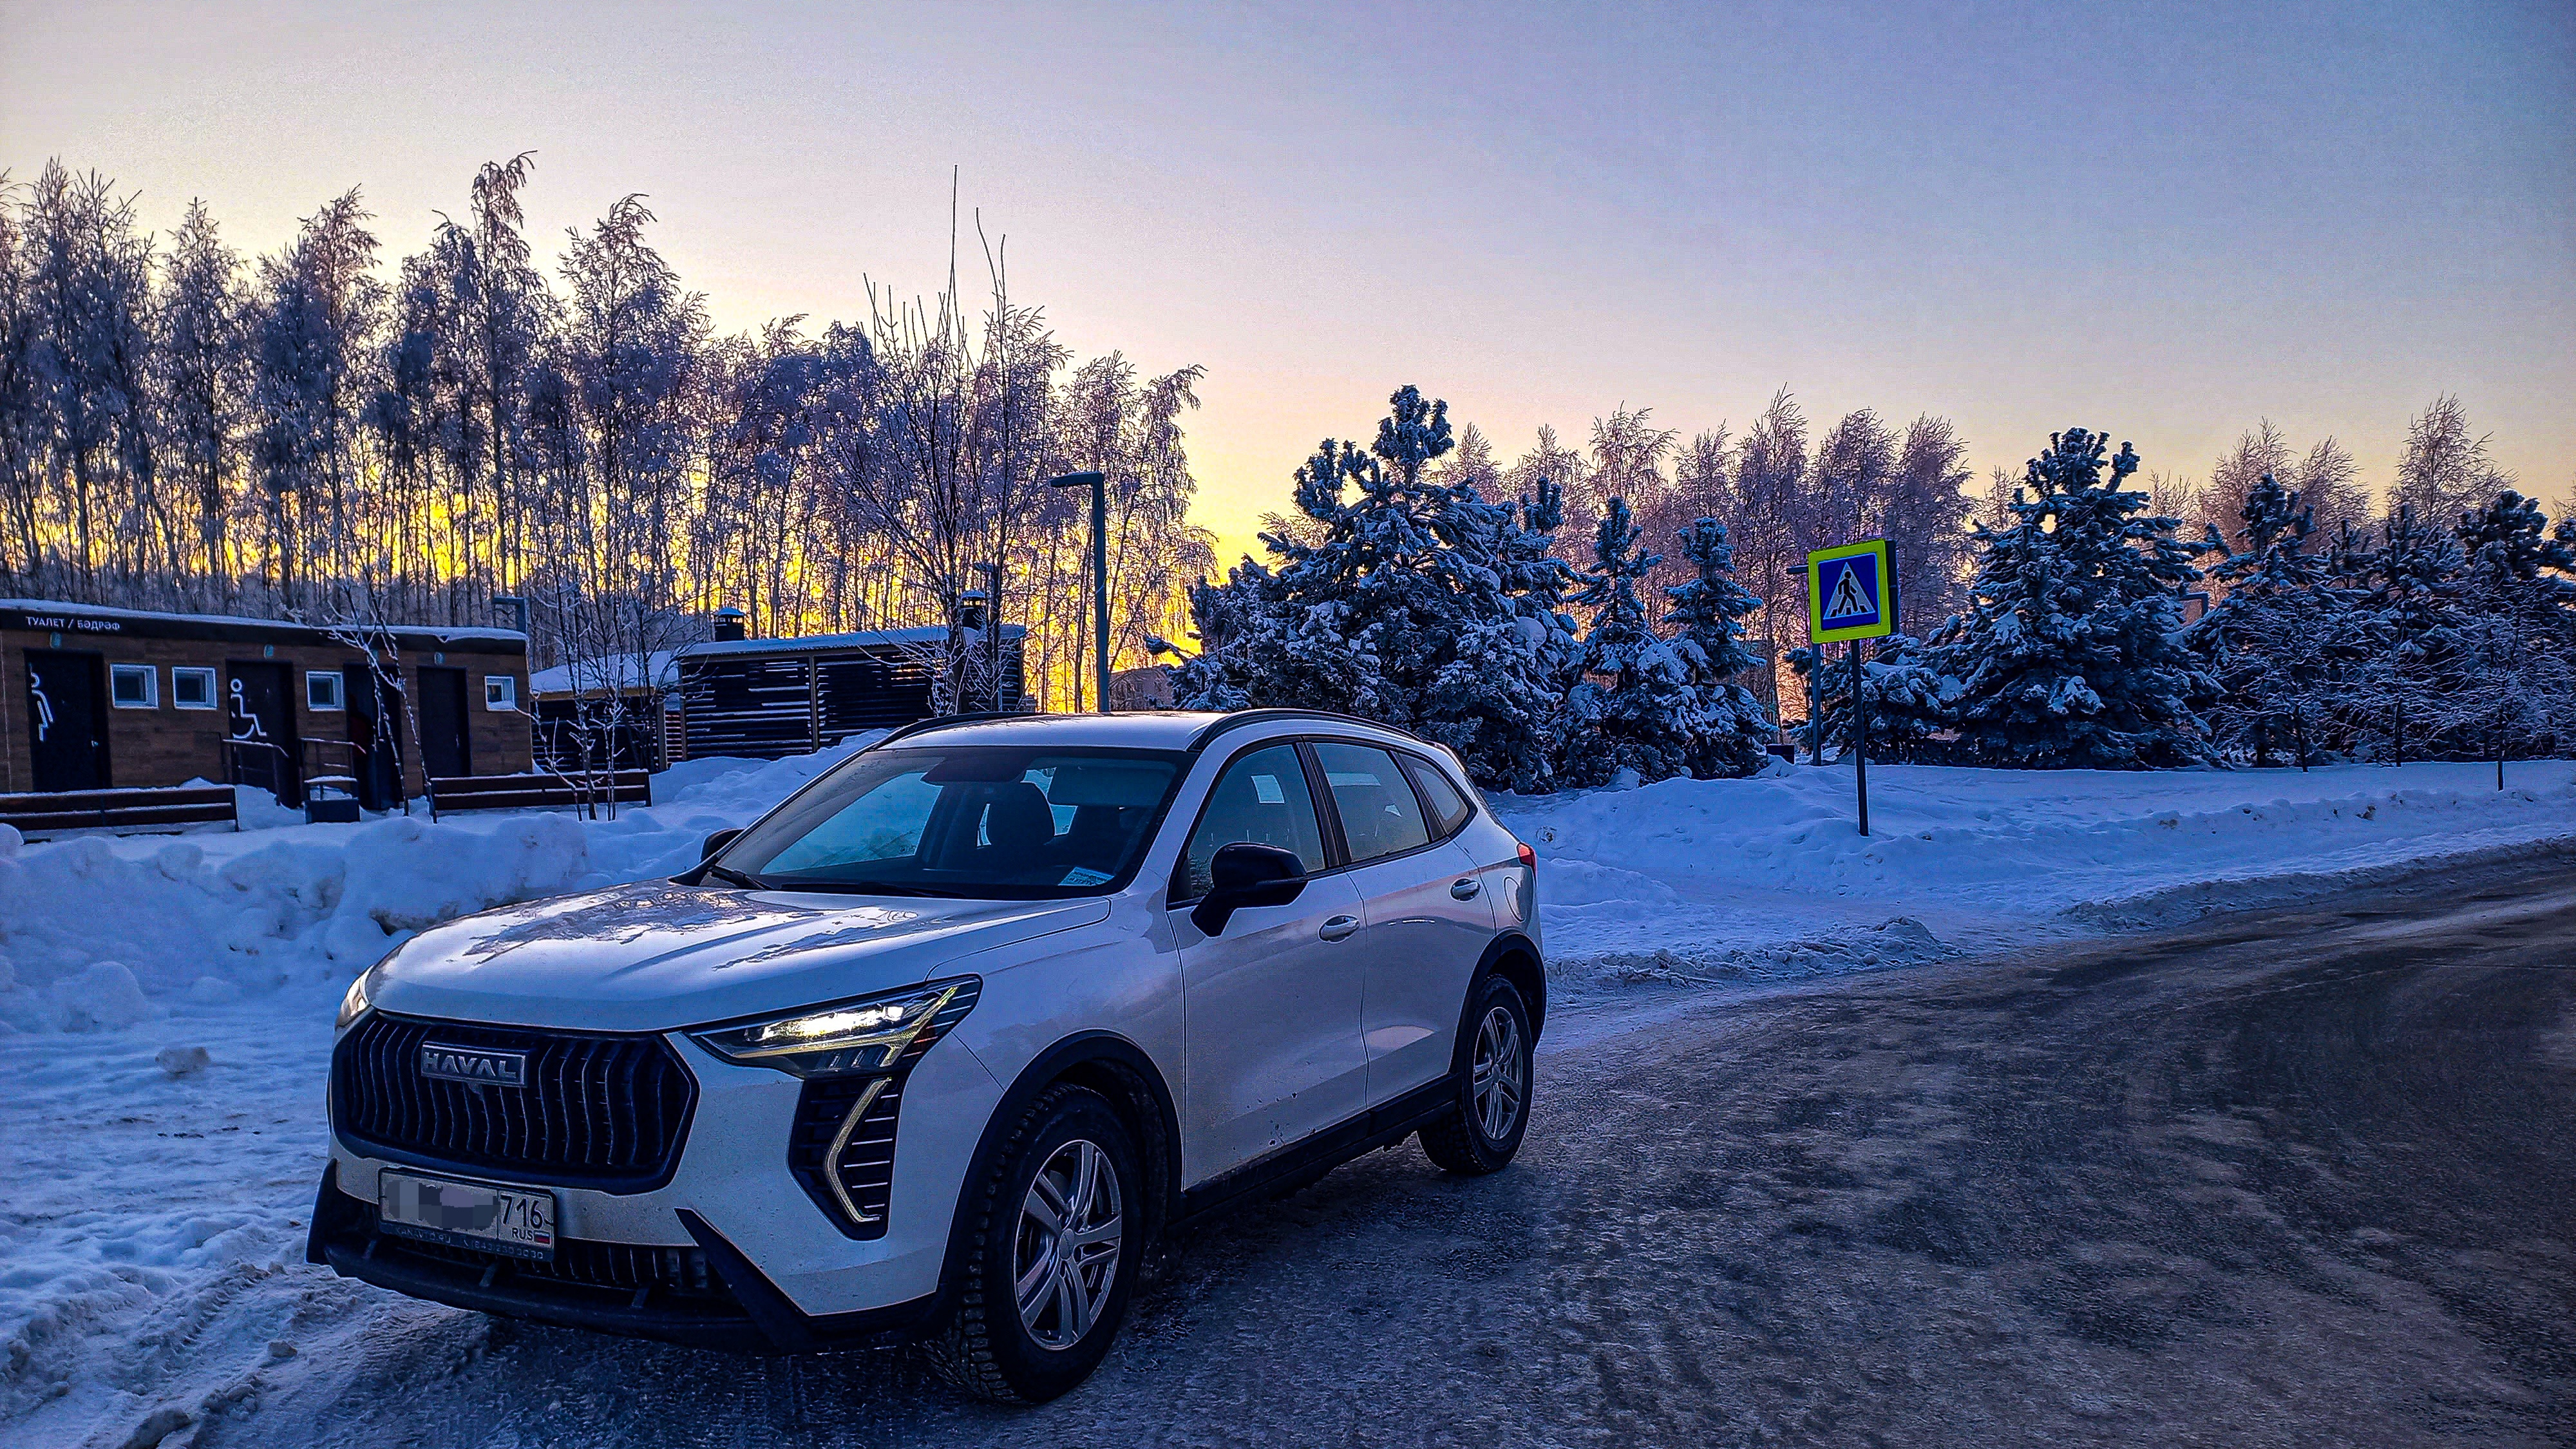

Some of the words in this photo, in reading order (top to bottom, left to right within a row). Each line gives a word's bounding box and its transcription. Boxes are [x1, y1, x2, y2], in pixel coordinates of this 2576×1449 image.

[26, 616, 65, 628] ТУАЛЕТ
[77, 620, 120, 631] БӘДРӘФ
[422, 1052, 516, 1079] HAVAL
[500, 1194, 544, 1229] 716
[512, 1227, 533, 1241] RUS
